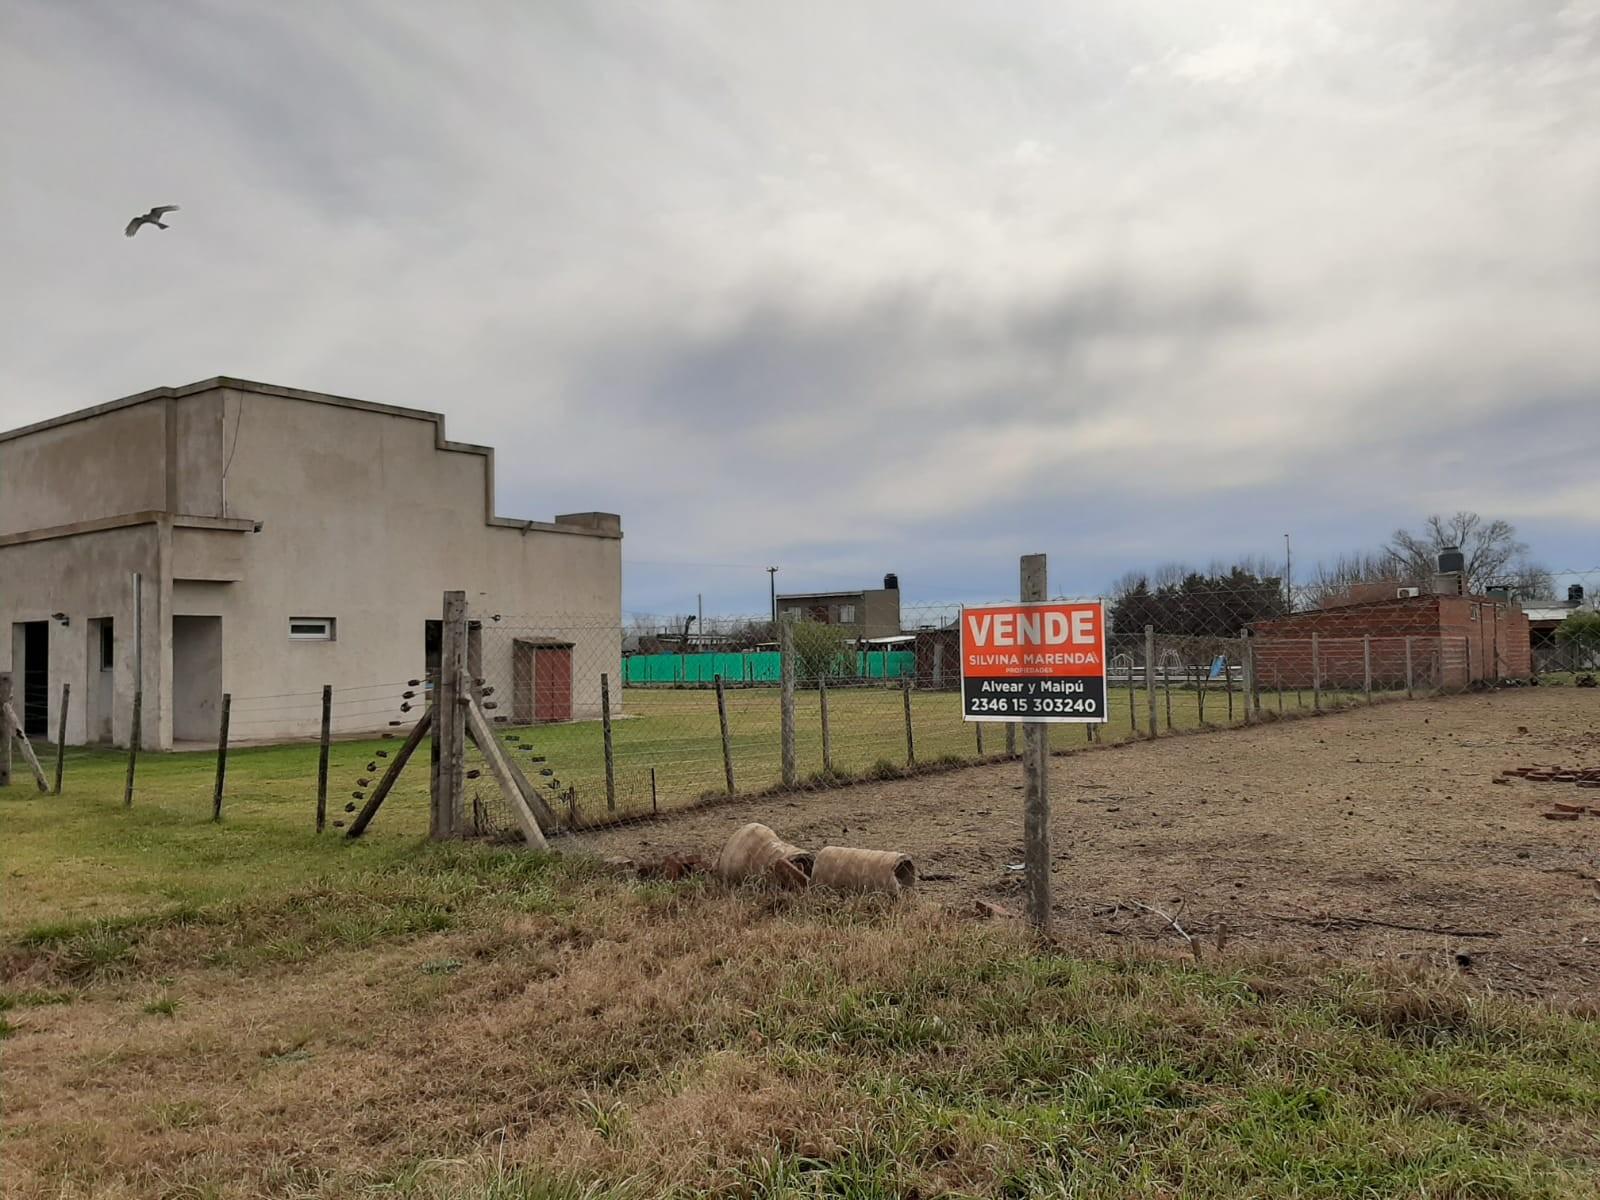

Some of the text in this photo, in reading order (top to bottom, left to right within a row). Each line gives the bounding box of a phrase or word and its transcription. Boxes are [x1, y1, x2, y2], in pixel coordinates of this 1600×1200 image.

[968, 610, 1095, 647] VENDE
[969, 652, 1097, 666] SILVINA MARENDA
[981, 680, 1084, 694] Alvear y Maipú
[971, 698, 1097, 712] 2346 15 303240
